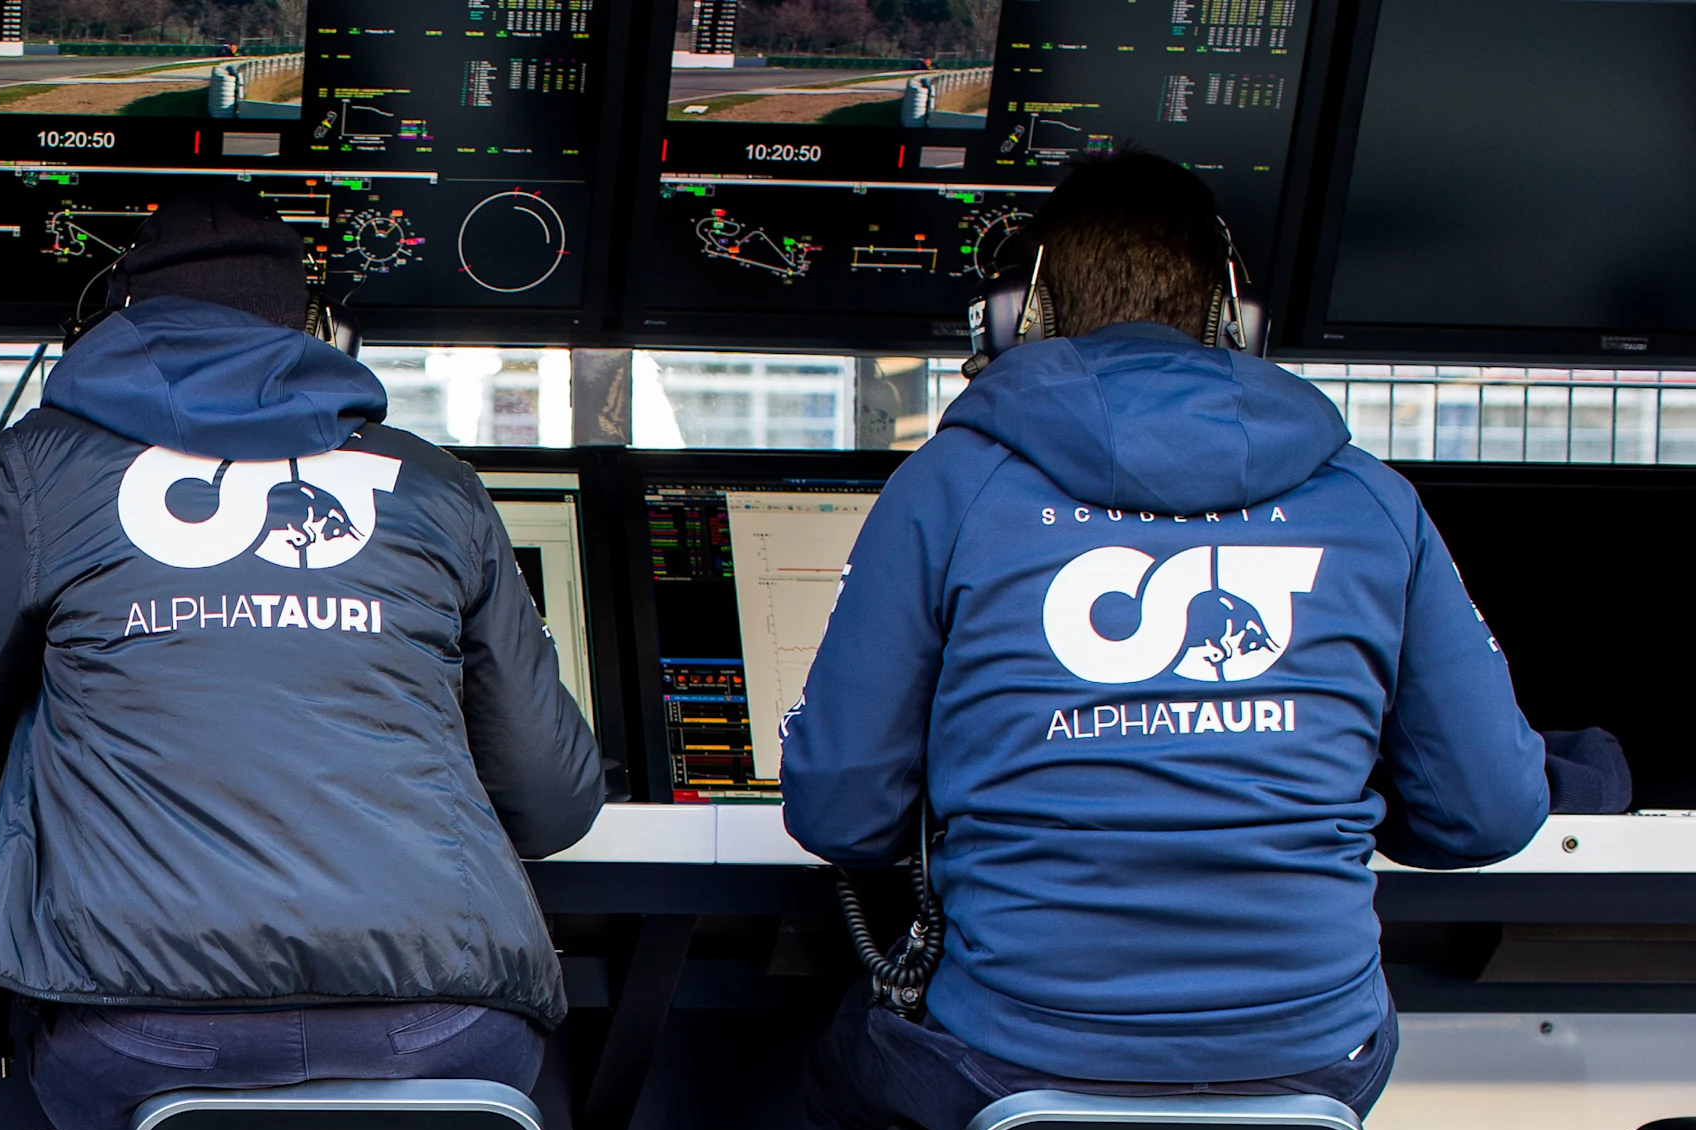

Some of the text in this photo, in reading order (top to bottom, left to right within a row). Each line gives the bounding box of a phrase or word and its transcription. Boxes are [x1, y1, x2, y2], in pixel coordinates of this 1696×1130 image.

[37, 131, 115, 148] 10:20:50
[745, 144, 821, 161] 10:20:50
[124, 594, 382, 637] ALPHATAURI
[1046, 700, 1295, 740] ALPHATAURI
